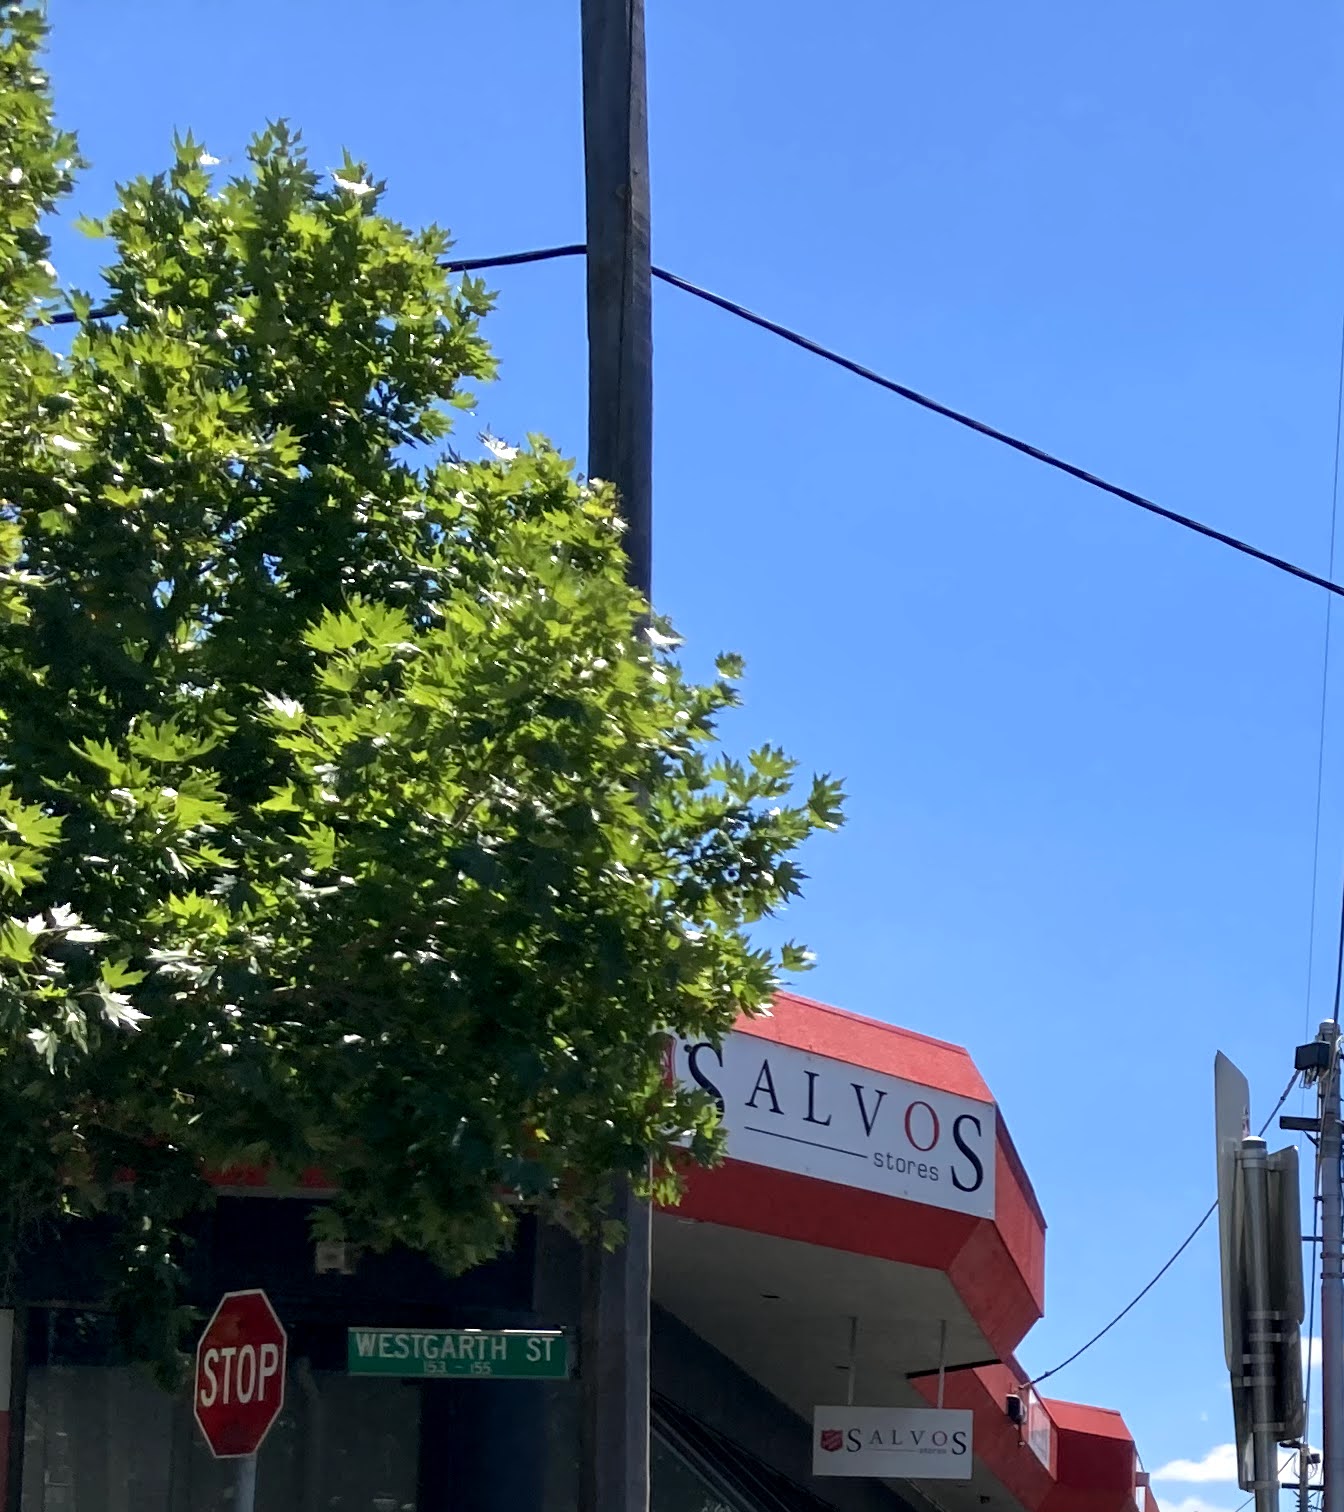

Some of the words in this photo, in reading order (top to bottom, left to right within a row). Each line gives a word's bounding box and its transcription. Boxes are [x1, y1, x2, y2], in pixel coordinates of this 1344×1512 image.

[686, 1042, 984, 1193] SALVOS
[873, 1151, 939, 1181] stores
[356, 1332, 507, 1361] WESTGARTH
[526, 1337, 555, 1362] ST
[201, 1343, 279, 1407] STOP
[846, 1428, 967, 1456] SALVOS
